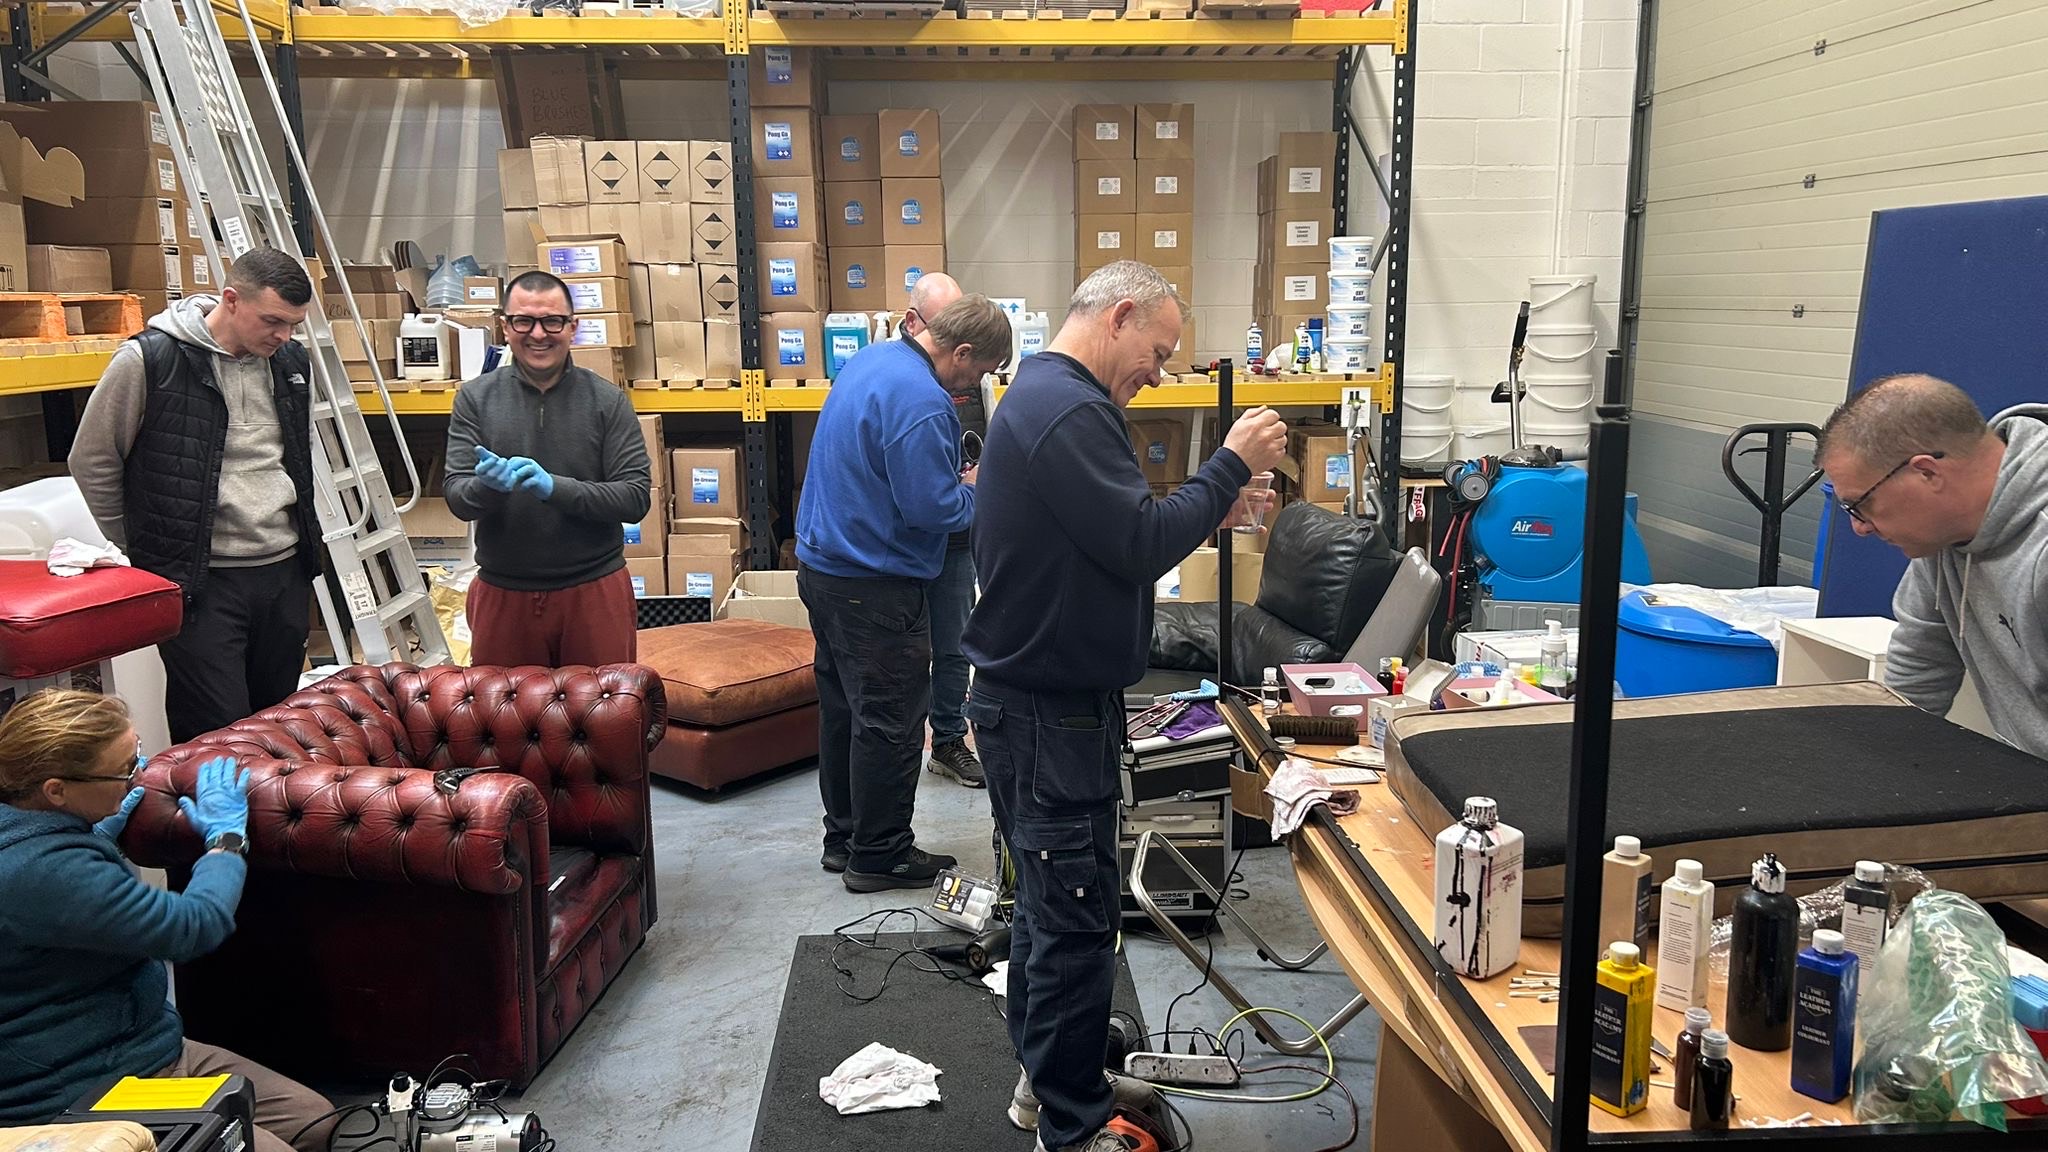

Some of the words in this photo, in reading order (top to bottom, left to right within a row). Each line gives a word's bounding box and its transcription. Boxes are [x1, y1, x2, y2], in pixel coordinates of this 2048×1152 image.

[532, 88, 569, 103] BLUE
[835, 343, 849, 351] Pong
[1799, 991, 1831, 1007] LEATHER
[1798, 1000, 1833, 1015] ACADEMY
